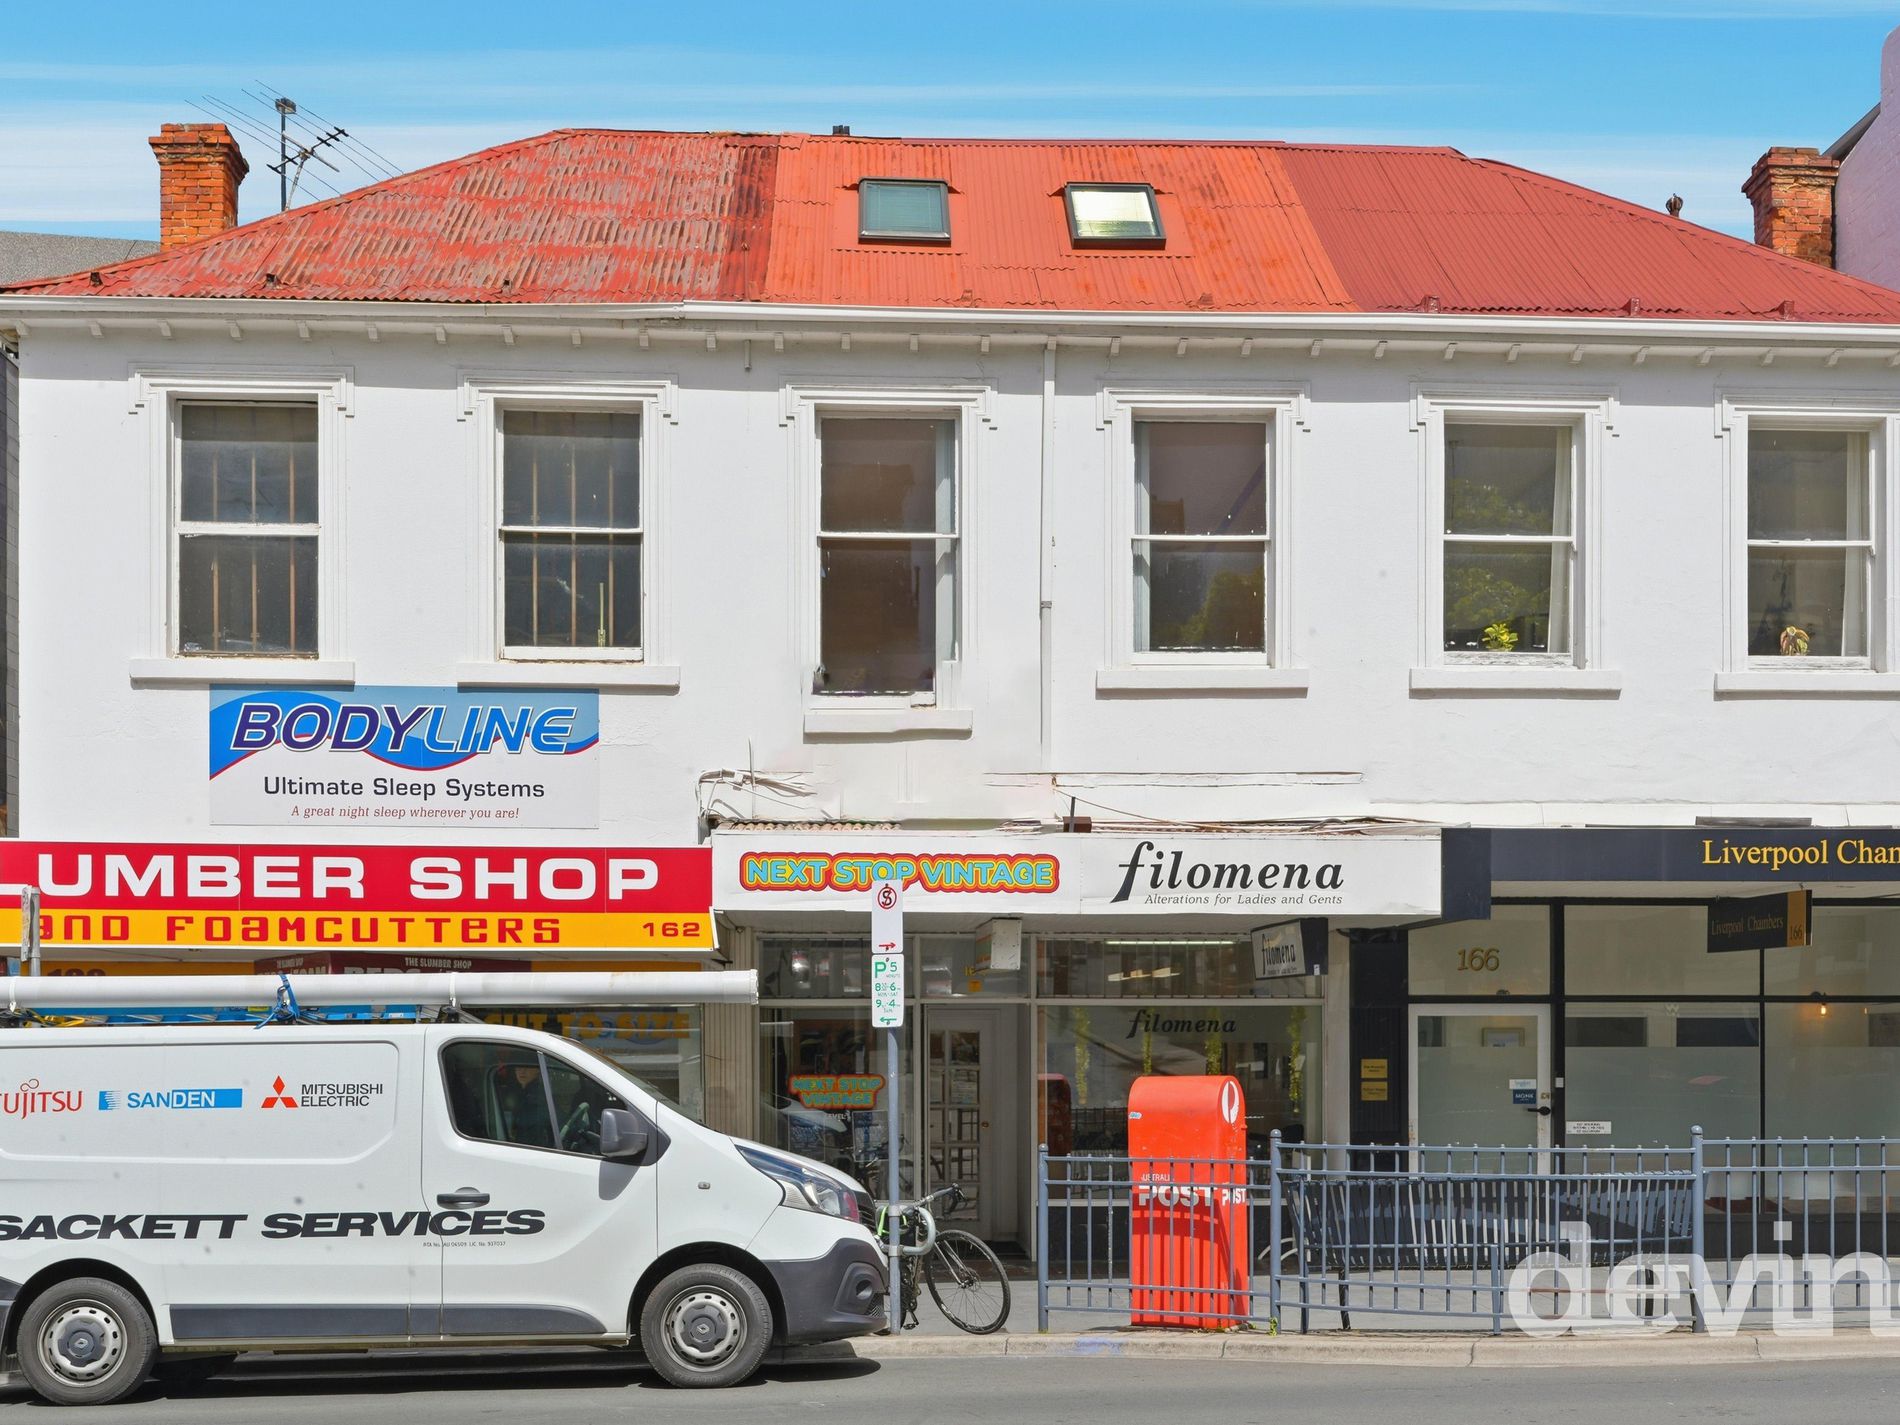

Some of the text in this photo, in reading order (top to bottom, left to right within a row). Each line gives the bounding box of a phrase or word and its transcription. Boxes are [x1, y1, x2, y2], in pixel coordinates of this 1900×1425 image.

[230, 703, 579, 755] BODYLINE
[263, 776, 545, 801] Ultimate Sleep Systems
[291, 806, 520, 820] A great night sleep wherever you are!
[1702, 839, 1829, 871] Liverpool
[409, 856, 659, 901] SHOP
[747, 859, 1052, 886] NEXT STOP VINTAGE
[1110, 840, 1344, 904] filomena
[1144, 893, 1343, 906] Alterations for Ladies and Gents
[642, 922, 700, 937] 162
[1711, 914, 1784, 938] Liverpool Chambers
[1789, 925, 1803, 941] 166
[405, 957, 472, 969] THE SLUMBER SHOP
[874, 961, 898, 978] P 5
[1456, 947, 1500, 972] 166
[557, 1013, 602, 1039] TO
[615, 1013, 690, 1039] SIZE
[1126, 1009, 1236, 1039] filomena
[839, 1078, 881, 1090] STOP
[0, 1080, 384, 1120] UJITSU SANDEN MITSUBISHI
[301, 1095, 370, 1108] ELECTRIC
[802, 1092, 872, 1105] VINTAGE
[1141, 1173, 1175, 1181] USTRALI
[1138, 1185, 1218, 1207] POST
[261, 1209, 546, 1239] SERVICES
